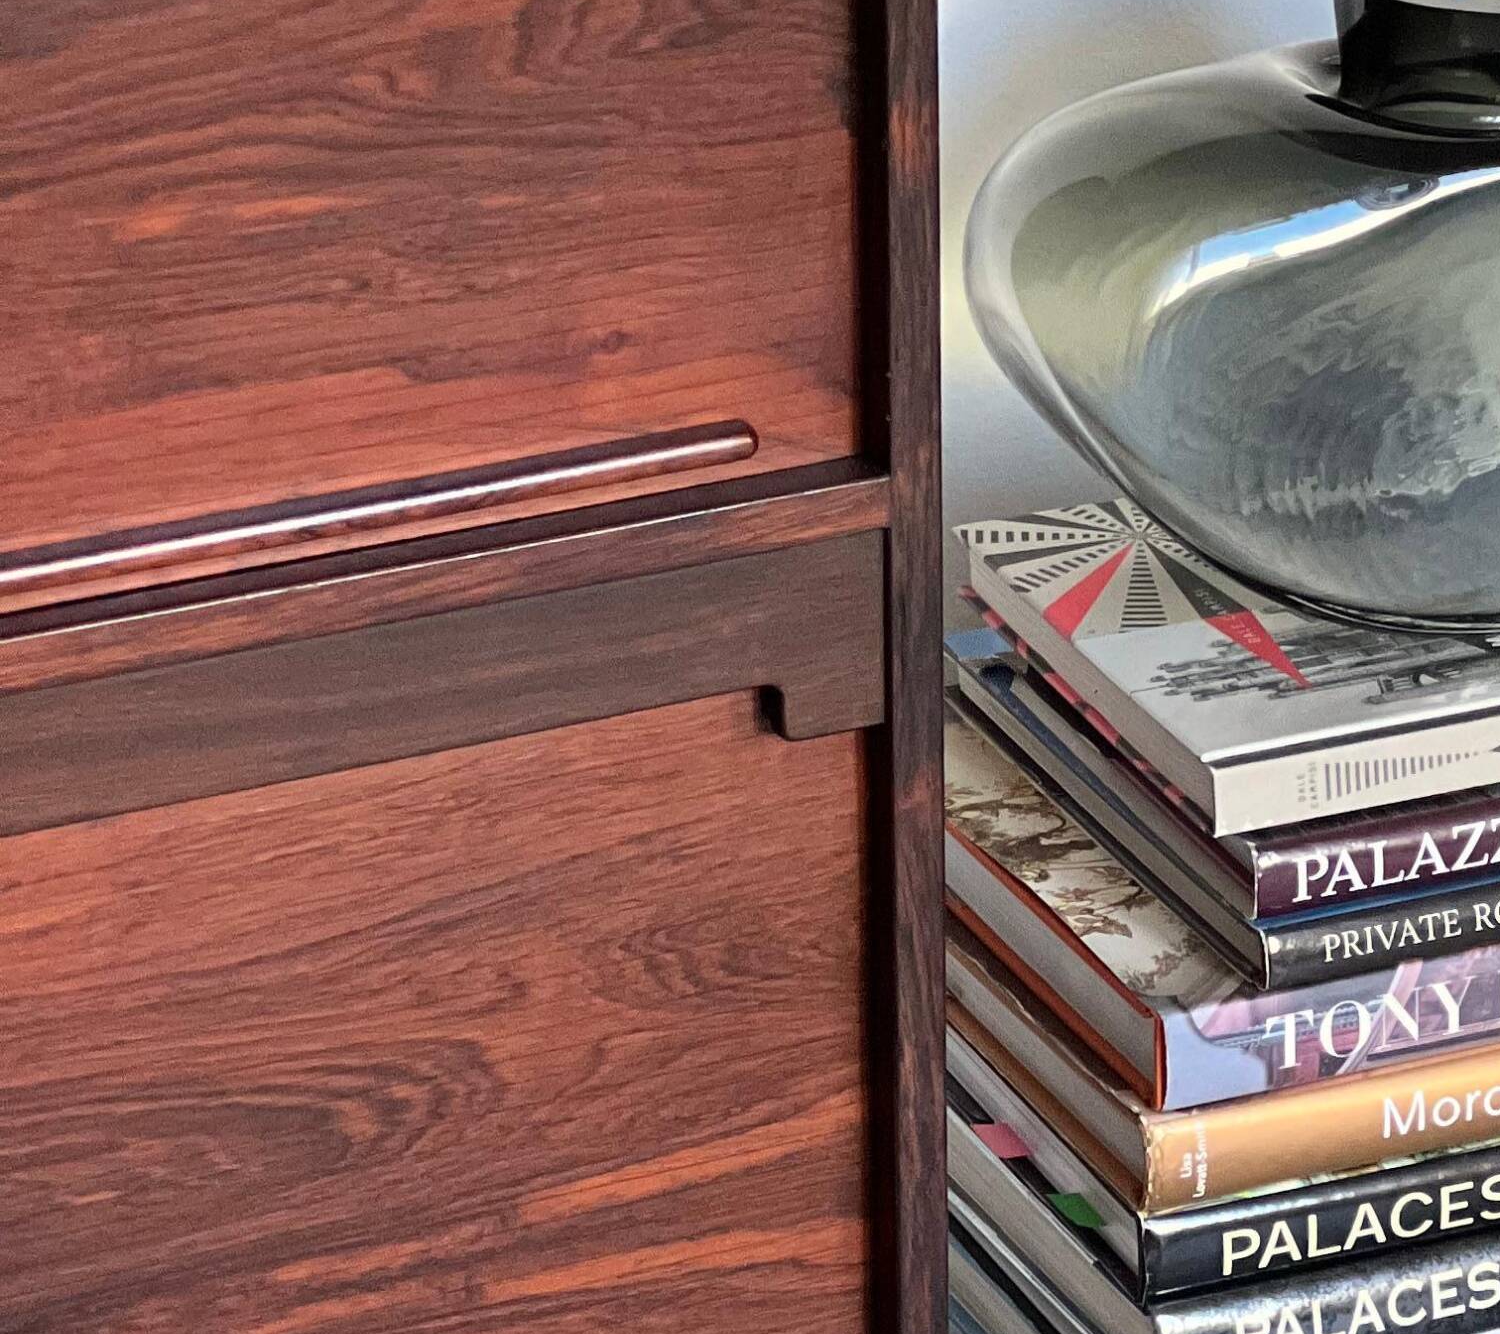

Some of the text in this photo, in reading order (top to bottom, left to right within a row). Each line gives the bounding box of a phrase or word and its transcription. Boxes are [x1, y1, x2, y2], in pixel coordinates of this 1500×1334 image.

[1322, 908, 1463, 964] PRIVATE
[1264, 975, 1477, 1070] TONY
[1180, 1152, 1193, 1179] Lisa
